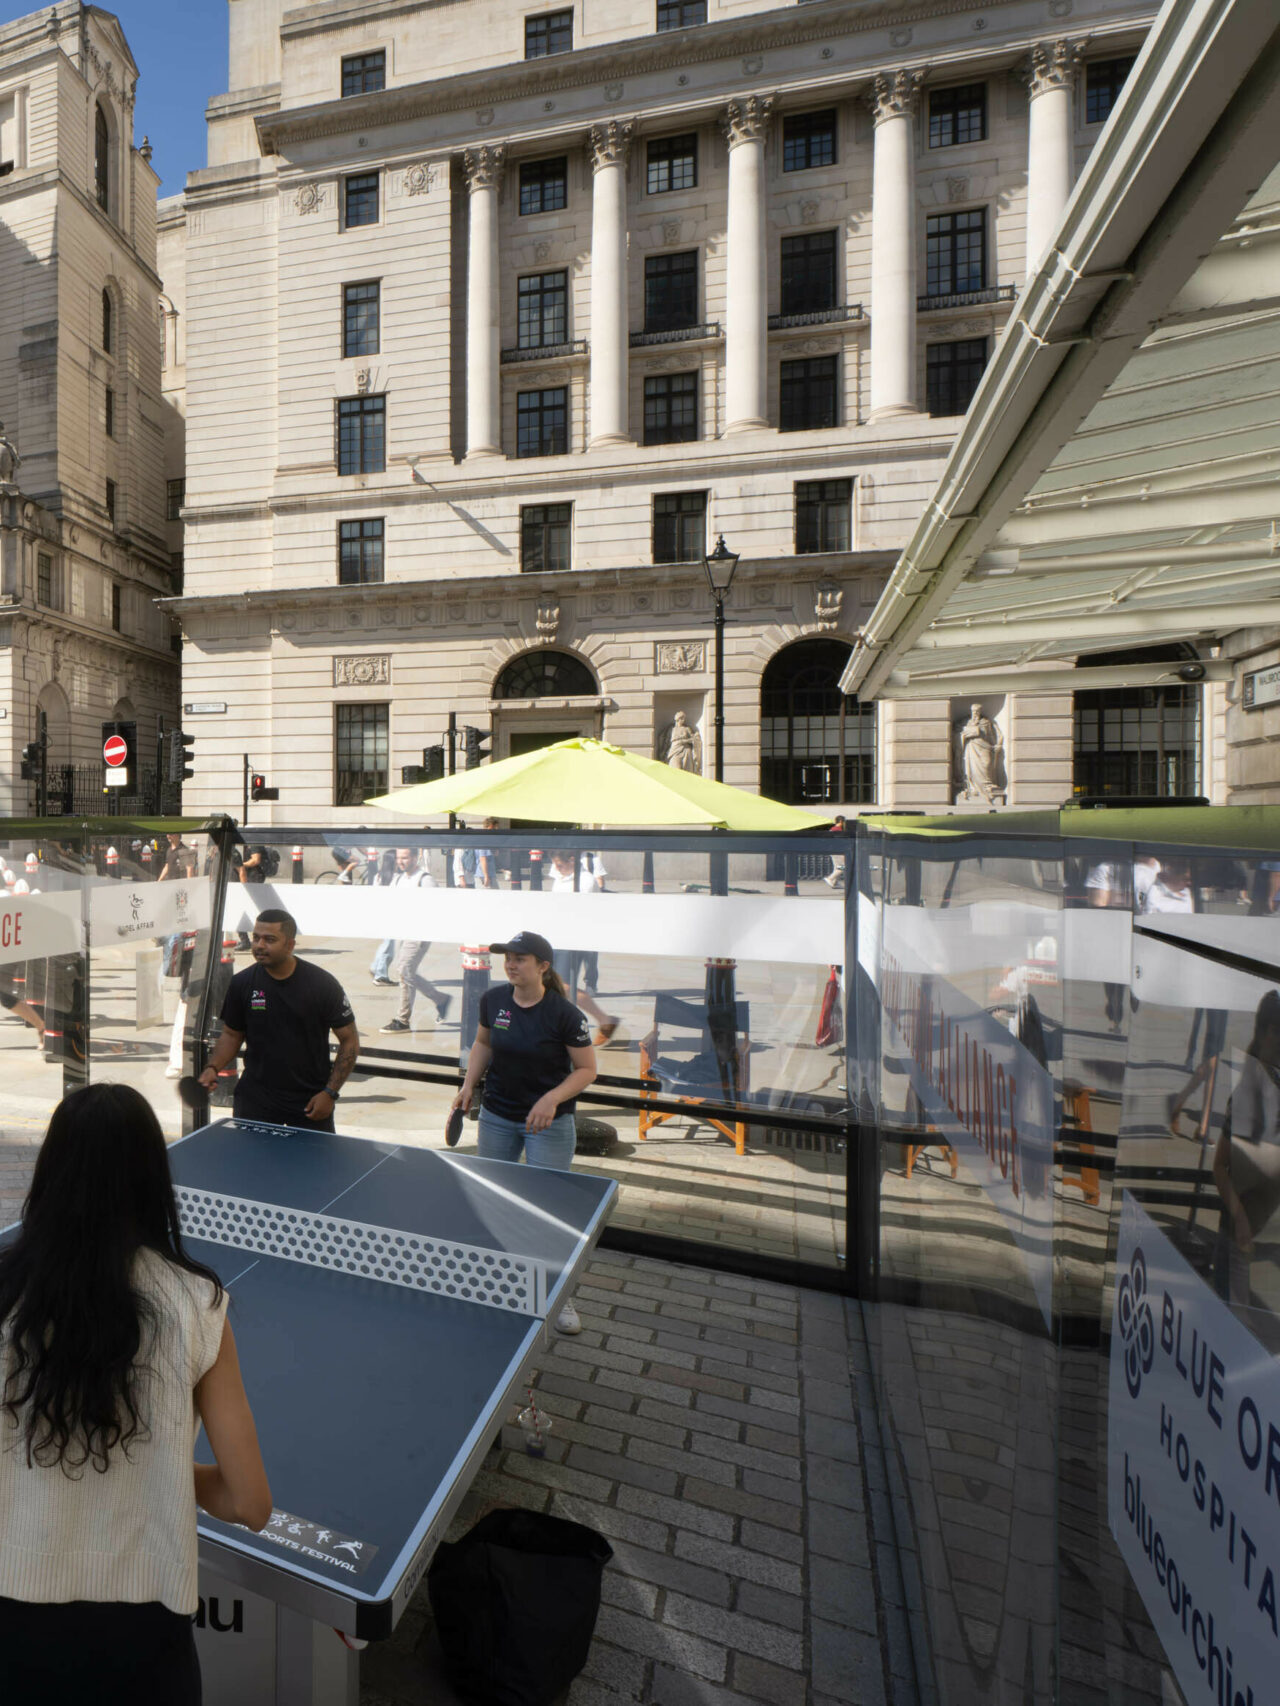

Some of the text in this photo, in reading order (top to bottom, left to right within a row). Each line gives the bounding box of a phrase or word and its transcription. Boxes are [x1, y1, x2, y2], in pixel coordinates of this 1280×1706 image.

[938, 1009, 1019, 1198] ALLIANCE
[1160, 1291, 1225, 1430] BLUE
[258, 1529, 358, 1574] PORTS FESTIVAL
[1160, 1402, 1279, 1638] HOSPITA
